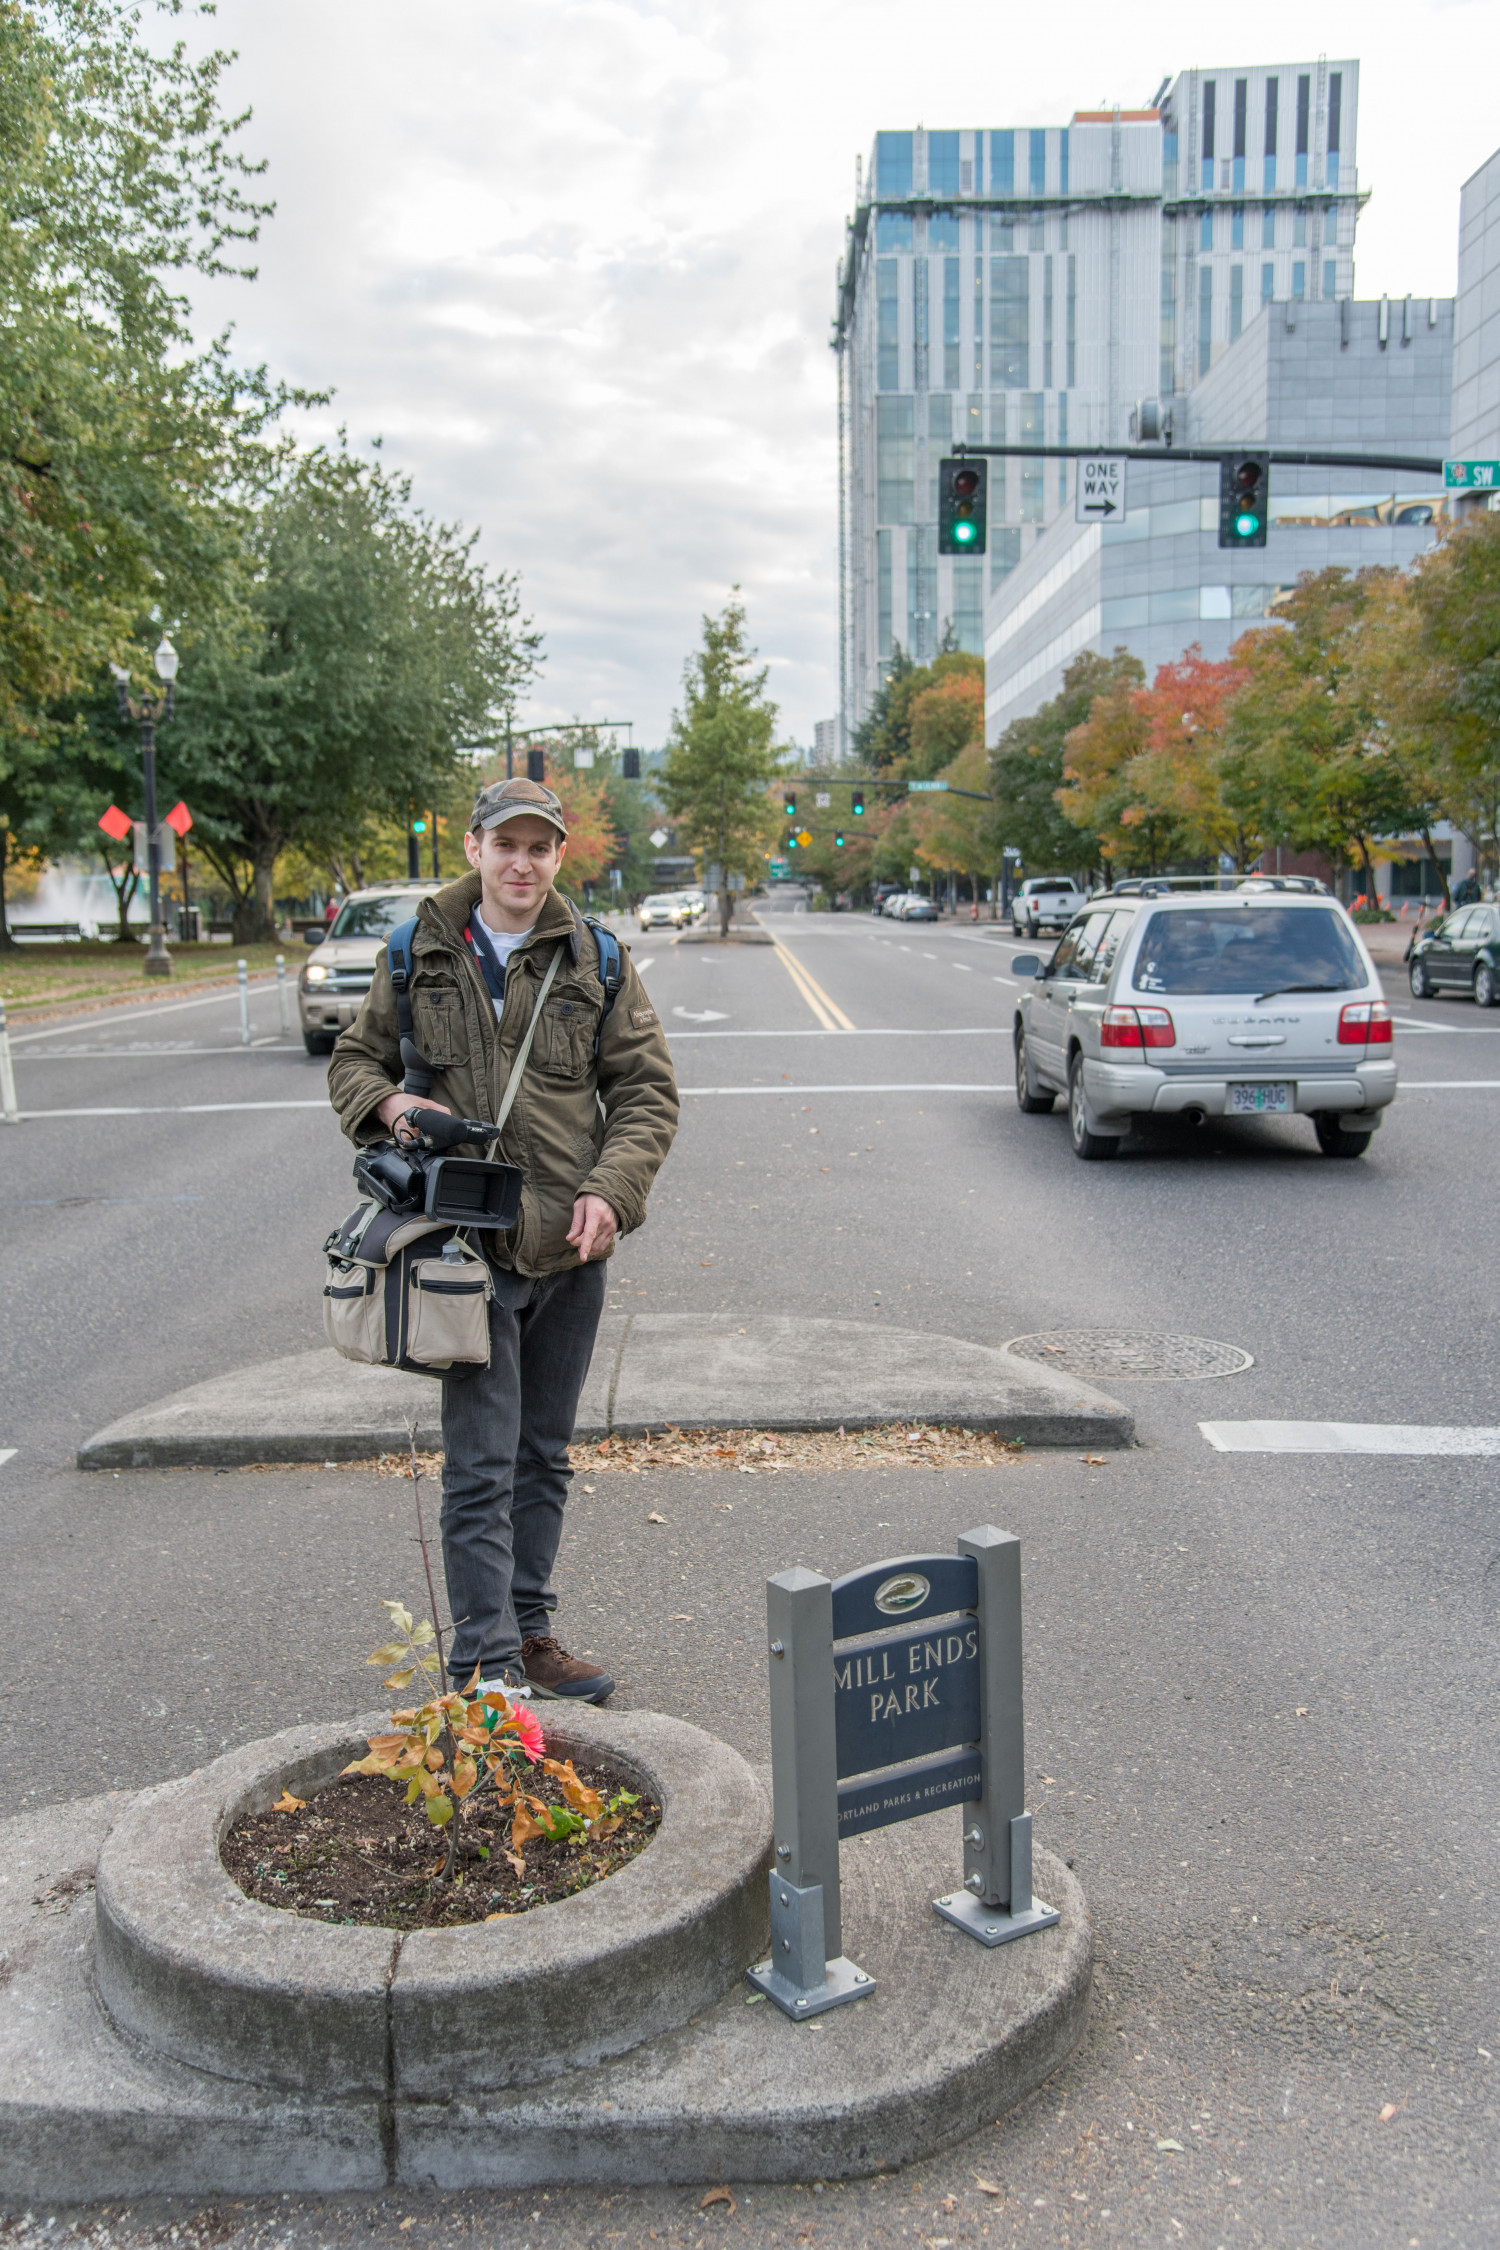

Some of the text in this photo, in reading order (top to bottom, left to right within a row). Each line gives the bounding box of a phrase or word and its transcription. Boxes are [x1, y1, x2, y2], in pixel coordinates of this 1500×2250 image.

[1086, 463, 1118, 478] ONE
[1473, 466, 1493, 486] SW
[1084, 481, 1119, 495] WAY
[1234, 1089, 1286, 1104] 396 HUG
[833, 1630, 977, 1691] MILL ENDS
[871, 1677, 940, 1722] PARK
[838, 1773, 981, 1822] ORTLAND PARKS & RECREATION
